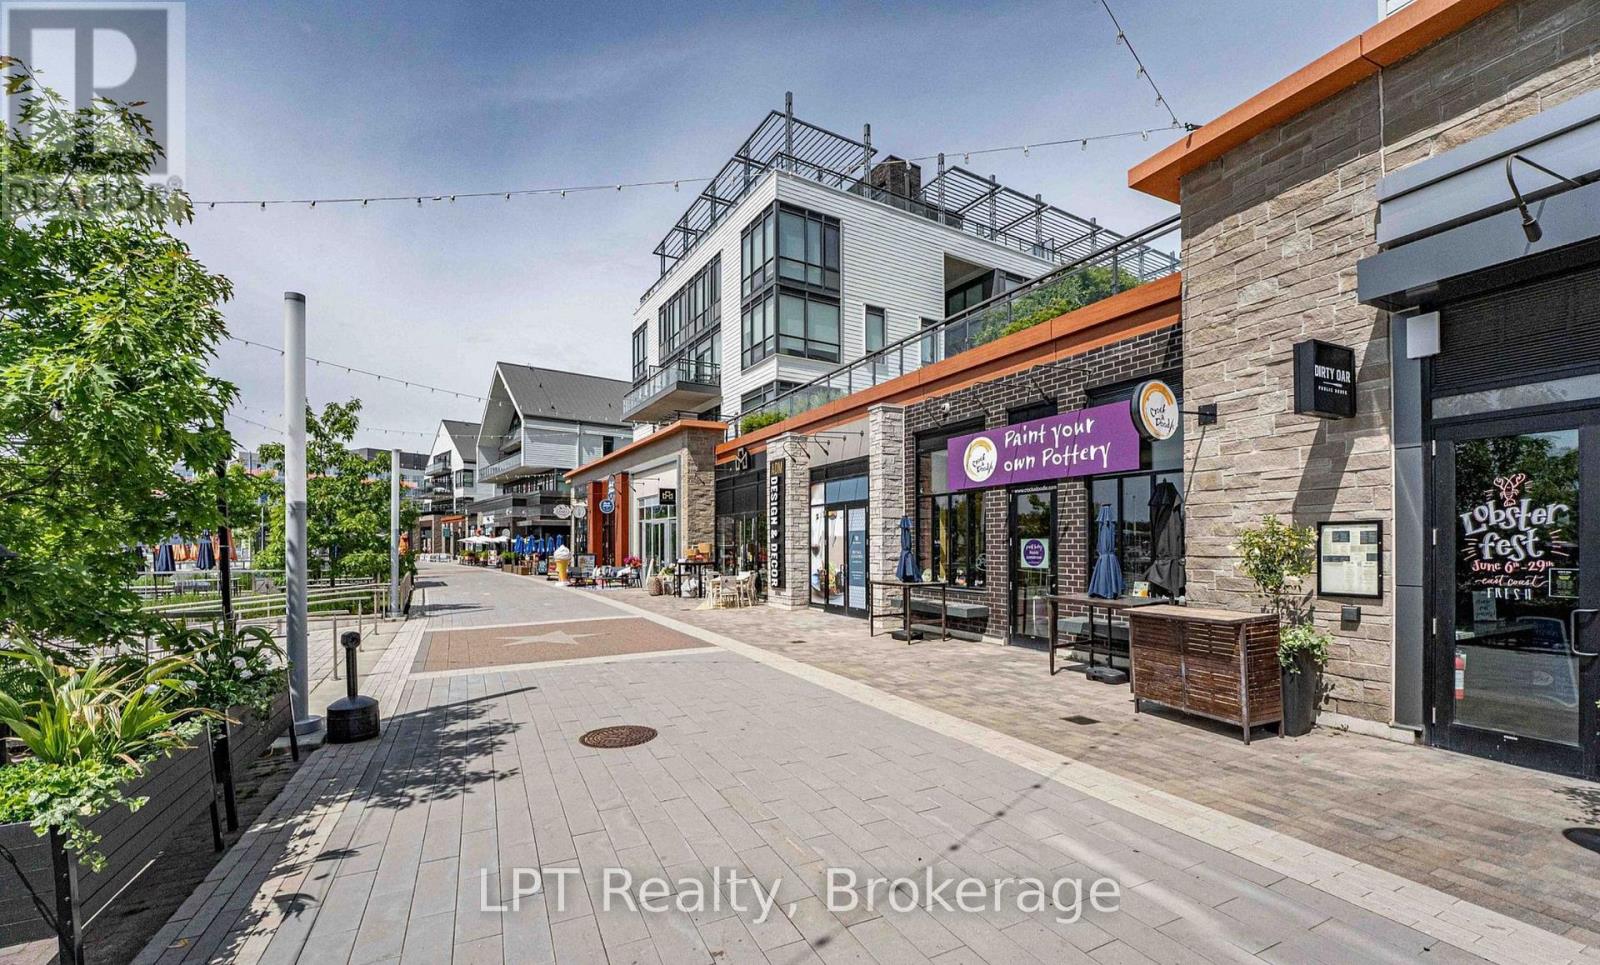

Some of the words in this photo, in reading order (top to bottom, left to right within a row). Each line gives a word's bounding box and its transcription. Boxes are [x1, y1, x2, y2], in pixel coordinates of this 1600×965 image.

[1314, 364, 1335, 380] DIRTY
[1336, 369, 1351, 383] OAR
[1004, 423, 1047, 449] Paint
[1050, 418, 1095, 448] your
[1003, 455, 1035, 472] own
[1042, 441, 1111, 469] Pottery
[770, 476, 779, 525] DESIGN
[1459, 498, 1569, 536] Lobster
[770, 530, 779, 539] &
[770, 543, 779, 588] DECOR
[1472, 559, 1501, 572] June
